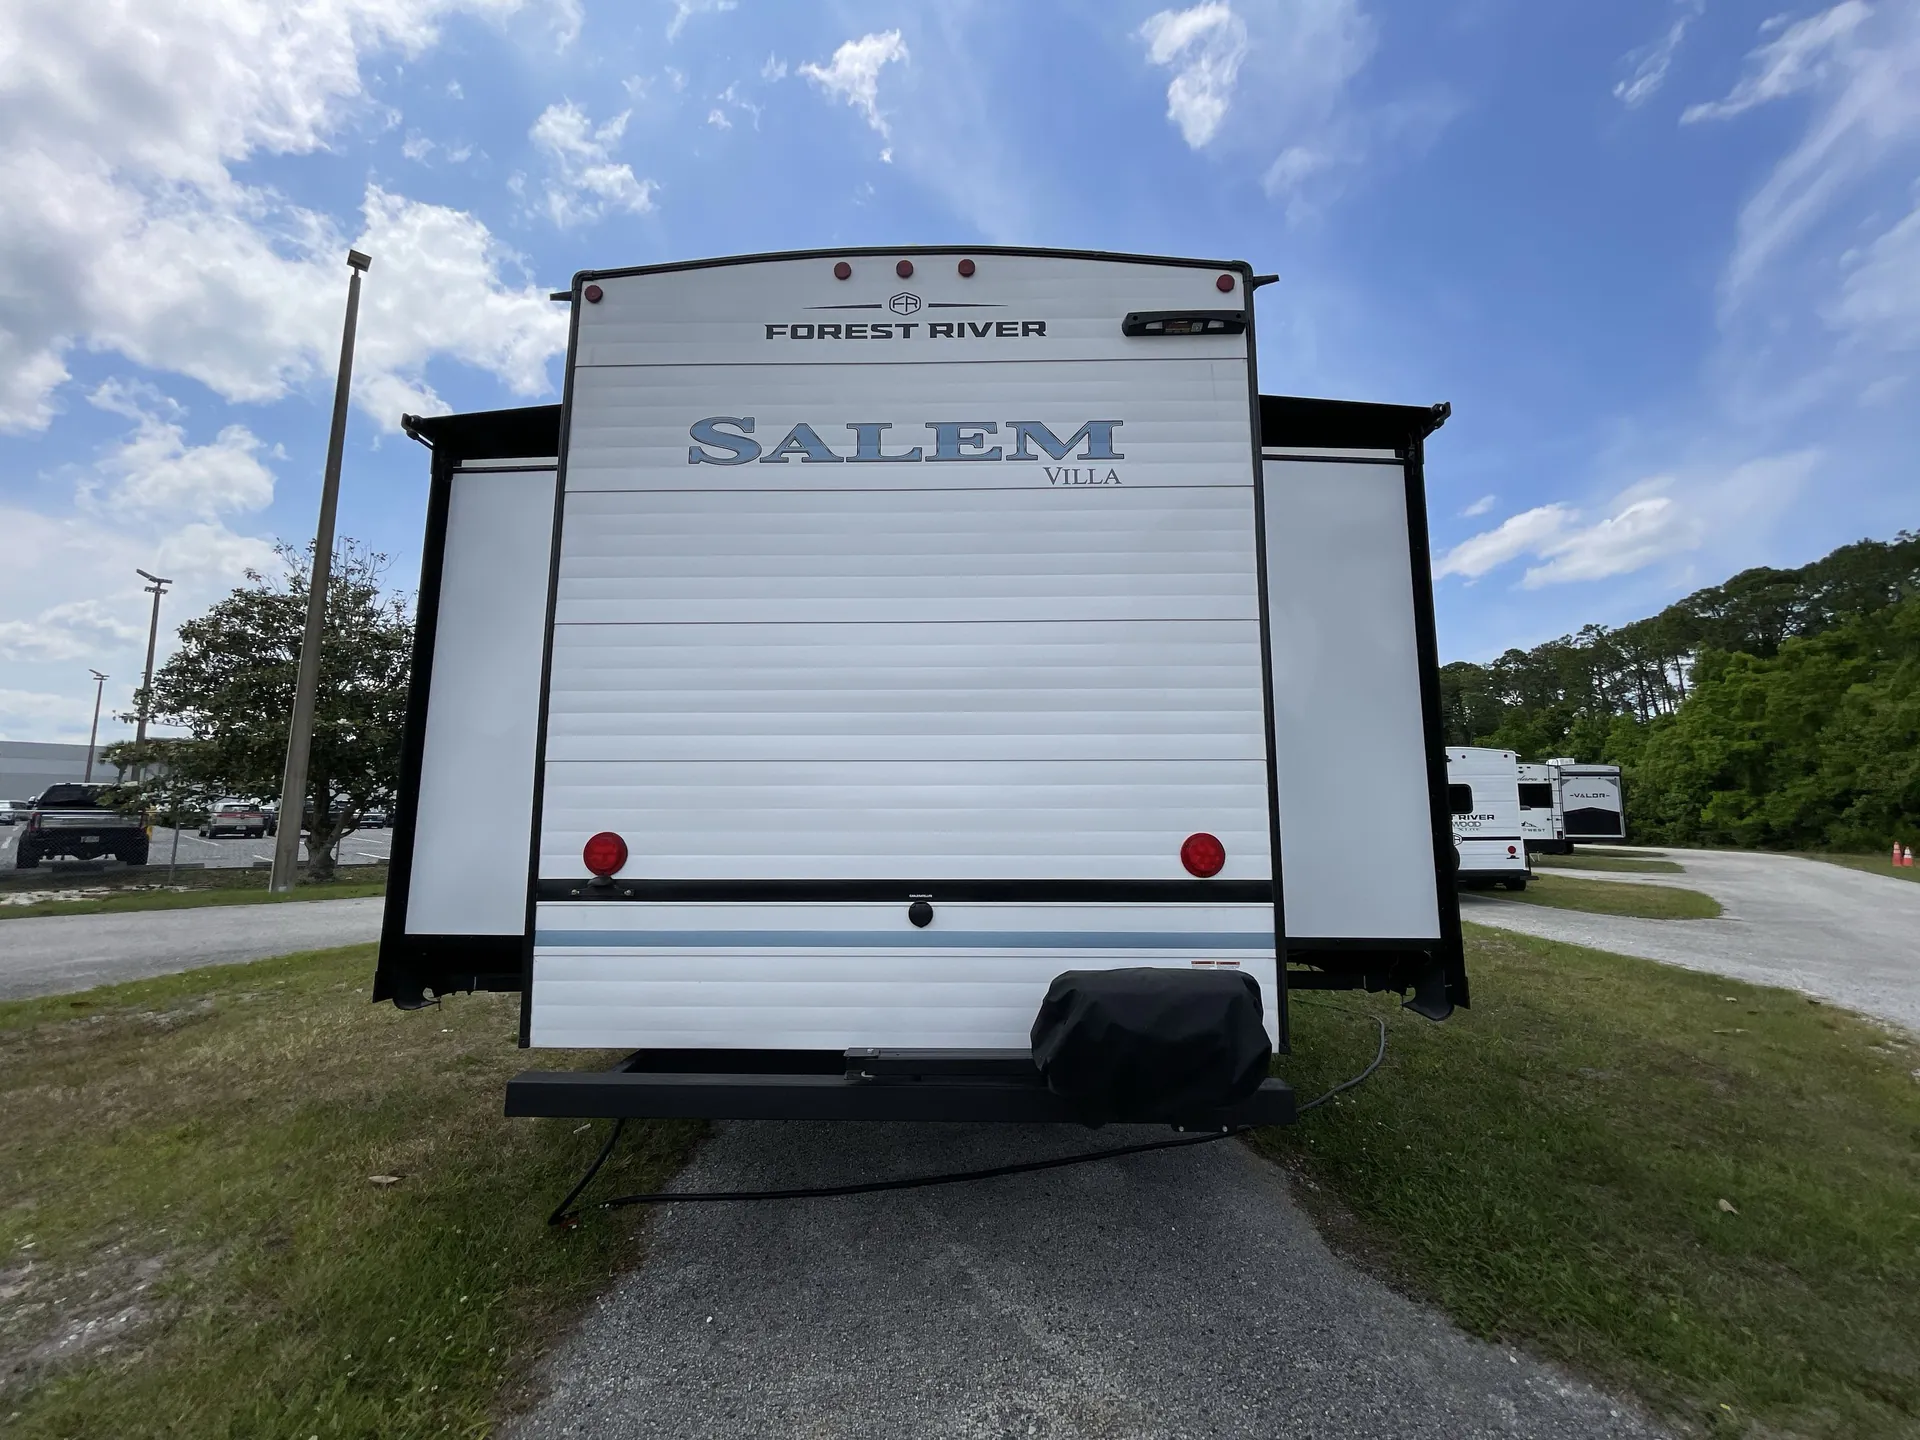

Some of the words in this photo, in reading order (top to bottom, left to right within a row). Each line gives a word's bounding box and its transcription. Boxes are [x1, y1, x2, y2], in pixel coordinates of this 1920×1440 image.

[764, 323, 919, 339] FOREST
[927, 321, 1047, 338] RIVER
[688, 416, 1125, 466] SALEM
[1043, 466, 1122, 485] VILLA
